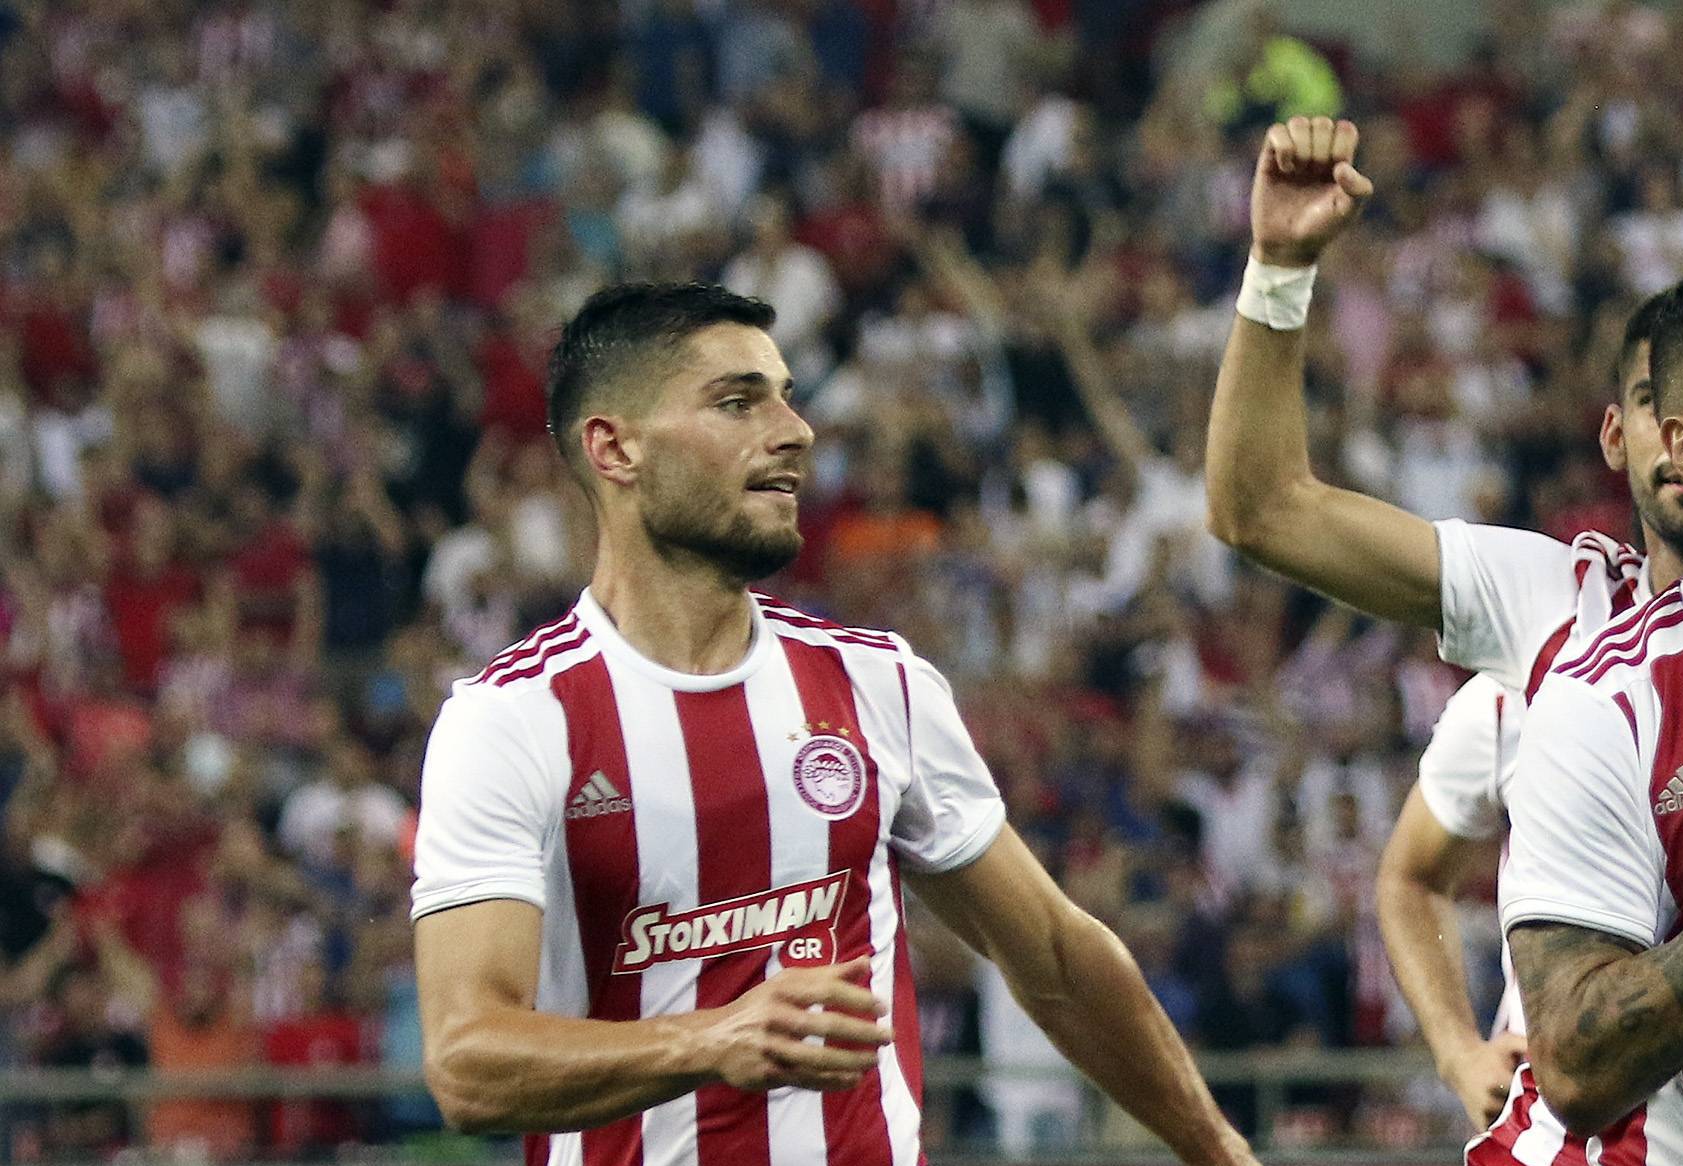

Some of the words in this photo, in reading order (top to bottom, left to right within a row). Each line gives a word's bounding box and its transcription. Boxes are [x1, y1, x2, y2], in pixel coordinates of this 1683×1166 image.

[566, 798, 632, 819] adidas
[623, 881, 841, 965] STOIXIMAN
[788, 937, 824, 960] GR
